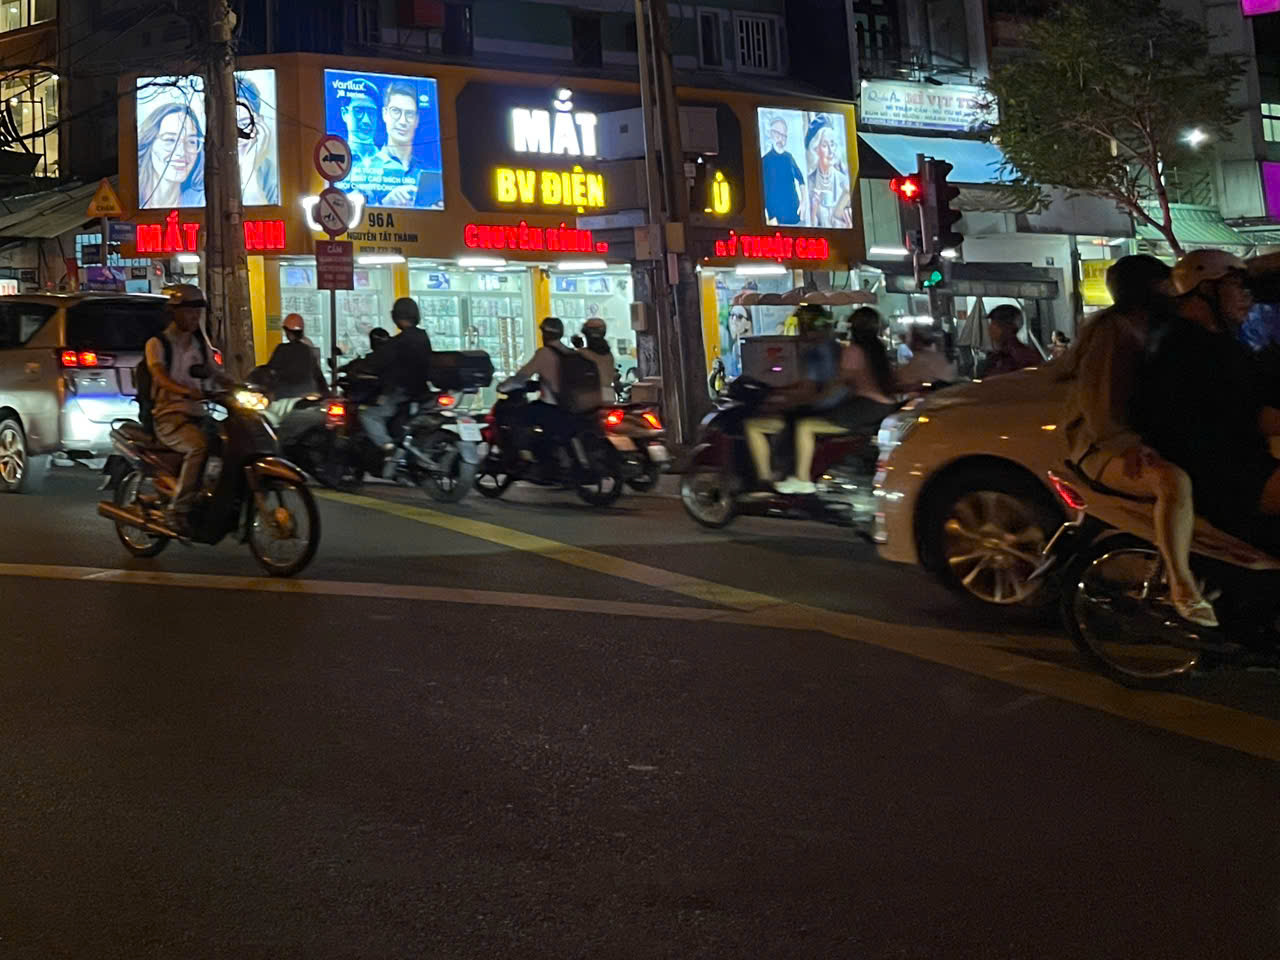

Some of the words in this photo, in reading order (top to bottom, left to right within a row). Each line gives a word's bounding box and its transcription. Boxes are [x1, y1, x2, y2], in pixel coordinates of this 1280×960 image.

[496, 167, 537, 204] BV
[540, 164, 606, 214] ĐIỆN
[136, 209, 201, 254] MẮT
